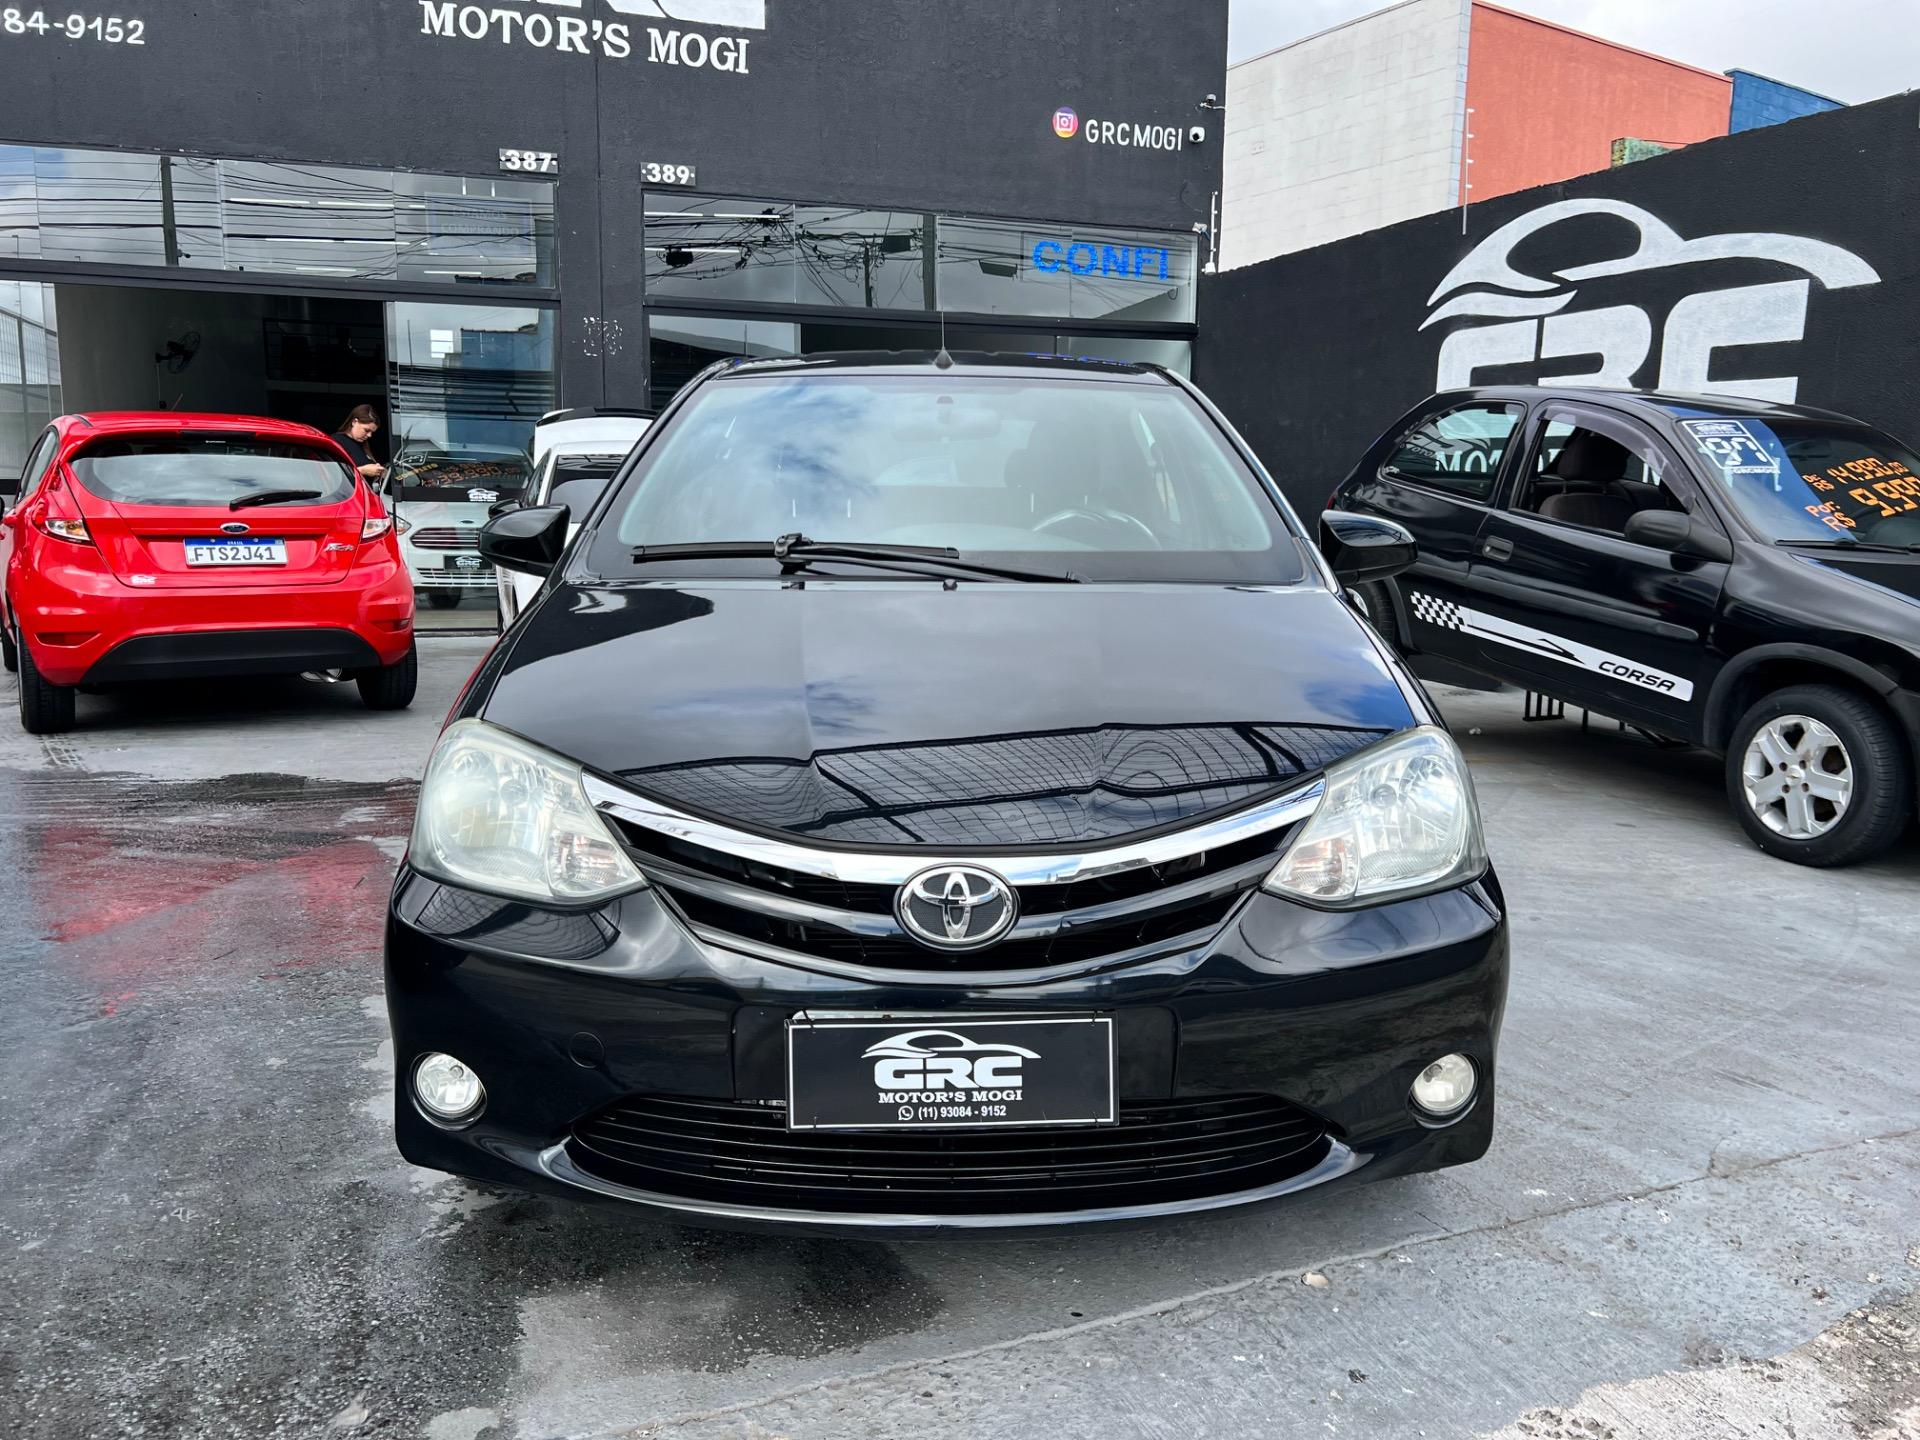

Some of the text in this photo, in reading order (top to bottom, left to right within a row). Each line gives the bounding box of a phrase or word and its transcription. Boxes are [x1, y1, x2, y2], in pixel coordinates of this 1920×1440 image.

[419, 0, 632, 59] MOTOR'S
[647, 27, 750, 75] MOGI
[1085, 119, 1184, 151] GRCMOGI
[505, 149, 552, 172] 387
[646, 162, 690, 185] 389
[1032, 240, 1169, 280] CONFI
[1821, 511, 1857, 532] R$
[193, 546, 276, 562] FTS2J41
[1598, 661, 1676, 691] CORSA
[873, 1055, 1024, 1090] GRC
[878, 1090, 1024, 1104] MOTOR'S MOGI
[917, 1106, 939, 1120] (11)
[940, 1106, 973, 1118] 93084
[981, 1105, 1007, 1117] 9152
